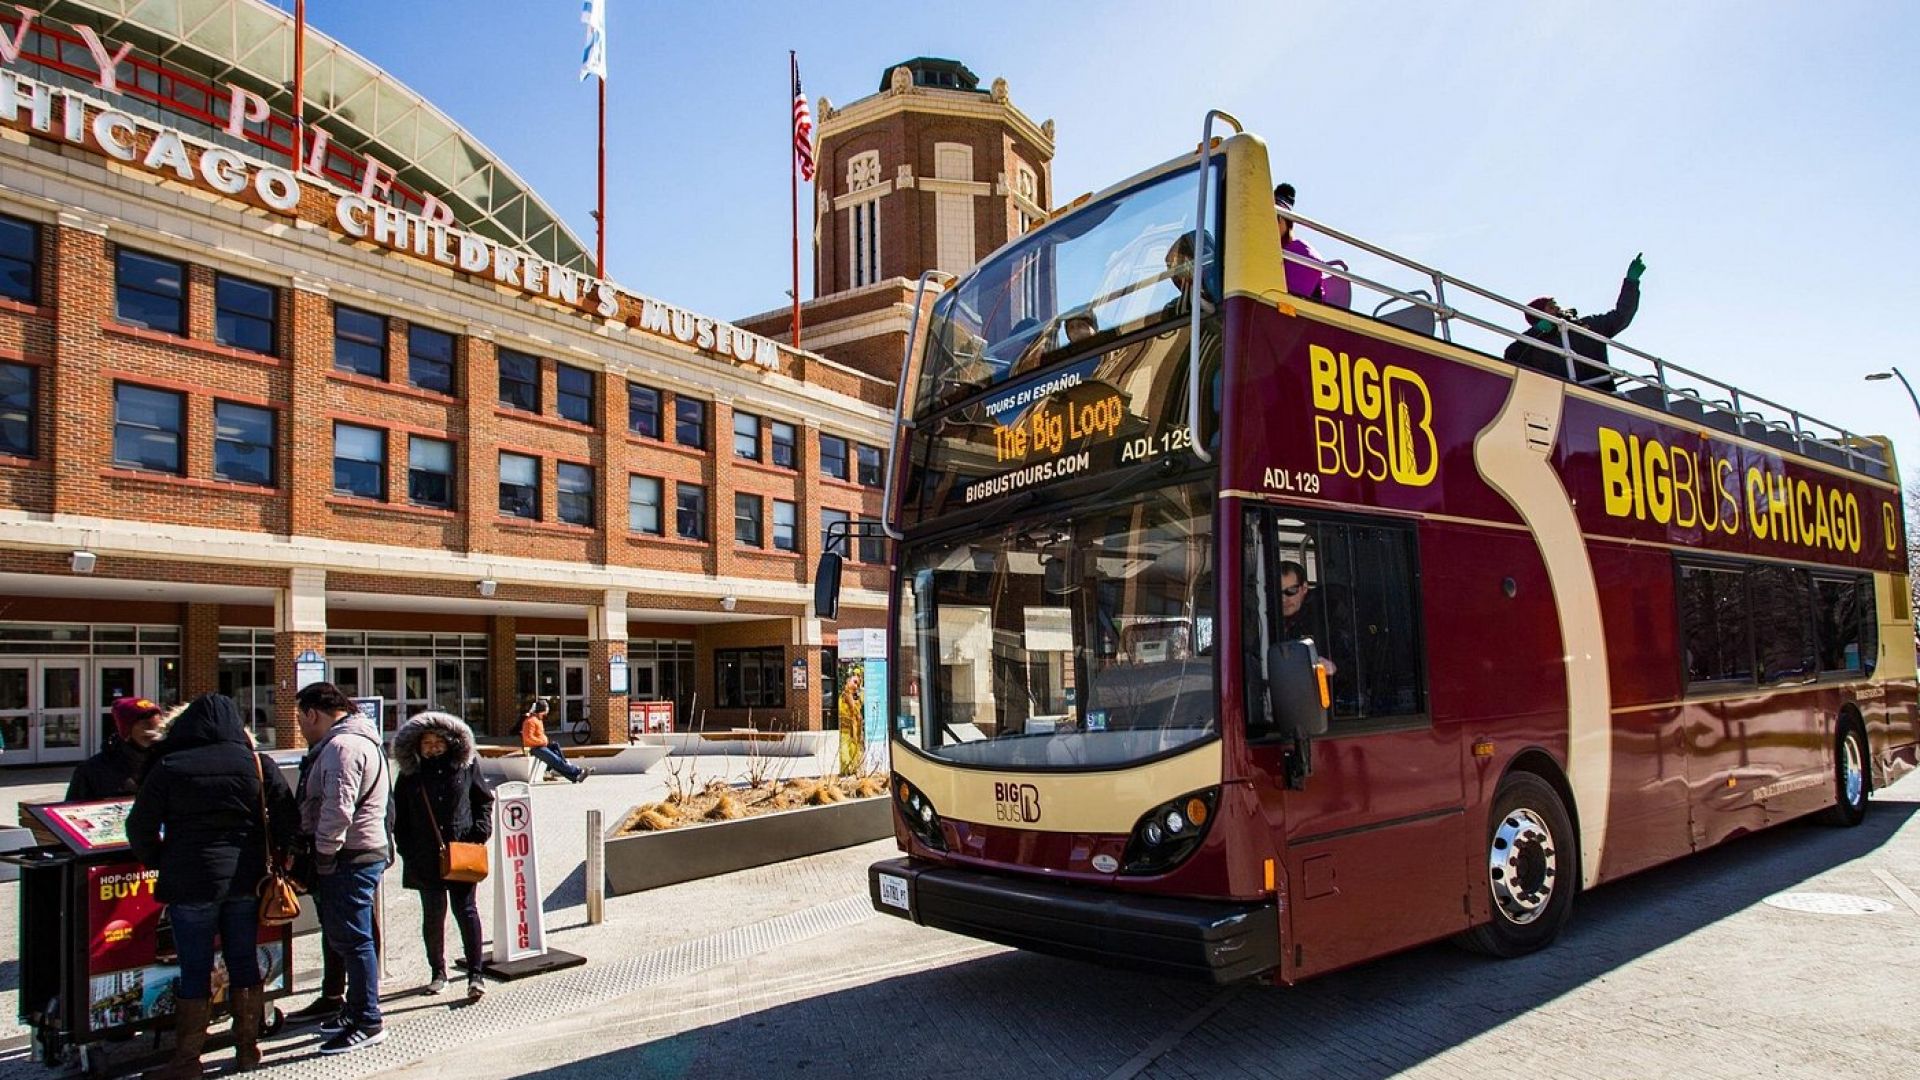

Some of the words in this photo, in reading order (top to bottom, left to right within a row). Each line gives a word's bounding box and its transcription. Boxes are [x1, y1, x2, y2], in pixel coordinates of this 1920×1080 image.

[336, 195, 618, 318] CHILDREN'S
[640, 298, 779, 371] MUSEUM
[985, 395, 1016, 418] TOURS
[1017, 391, 1031, 405] EN
[1033, 372, 1083, 402] ESPAÑOL
[1309, 344, 1382, 421] BIG
[994, 424, 1027, 463] The
[1032, 410, 1063, 455] Big
[1070, 395, 1122, 439] Loop
[1121, 436, 1159, 463] ADL
[1161, 427, 1193, 453] 129
[1315, 415, 1388, 482] BUS
[966, 451, 1091, 504] BIGBUSTOURS.COM
[1263, 466, 1295, 491] ADL
[1295, 471, 1320, 495] 129
[1748, 466, 1861, 555] CHICAGO
[994, 782, 1019, 803] BIG
[996, 802, 1021, 823] BUS
[506, 833, 529, 858] NO
[100, 872, 141, 885] HOP-ON
[100, 880, 141, 901] BUY
[513, 860, 530, 949] PARKING
